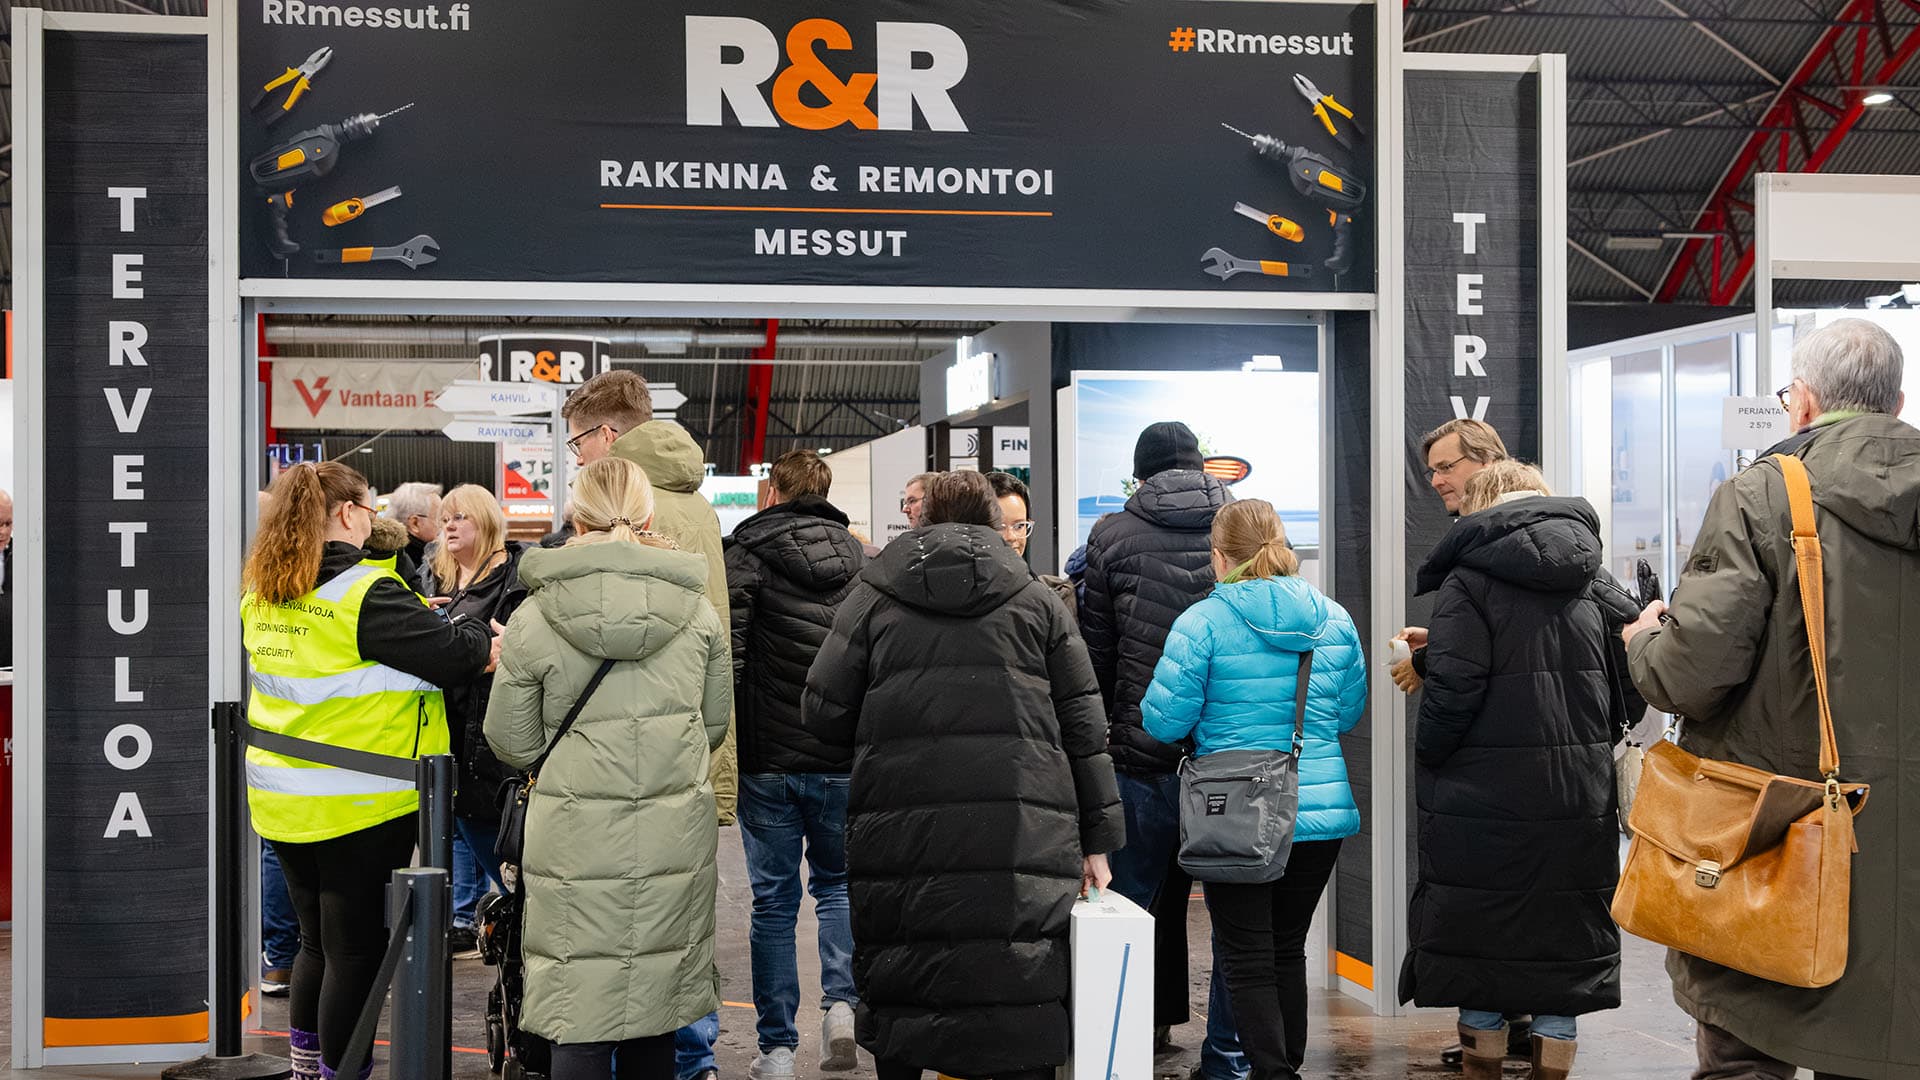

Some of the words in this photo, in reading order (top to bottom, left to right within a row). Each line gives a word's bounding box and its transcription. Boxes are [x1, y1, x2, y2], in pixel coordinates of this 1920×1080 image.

[263, 0, 470, 30] RRmessut.fi
[1168, 27, 1354, 55] #RRmessut
[685, 15, 969, 132] R&R
[600, 159, 788, 191] RAKENNA
[810, 164, 839, 192] &
[859, 165, 1053, 196] REMONTOI
[754, 228, 908, 257] MESSUT
[510, 350, 586, 383] R&R
[339, 389, 417, 408] Vantaan
[1738, 407, 1784, 416] PERJANTAI
[478, 425, 534, 439] RAVINTOLA
[103, 187, 153, 838] TERVETULOA
[255, 646, 295, 659] SECURITY
